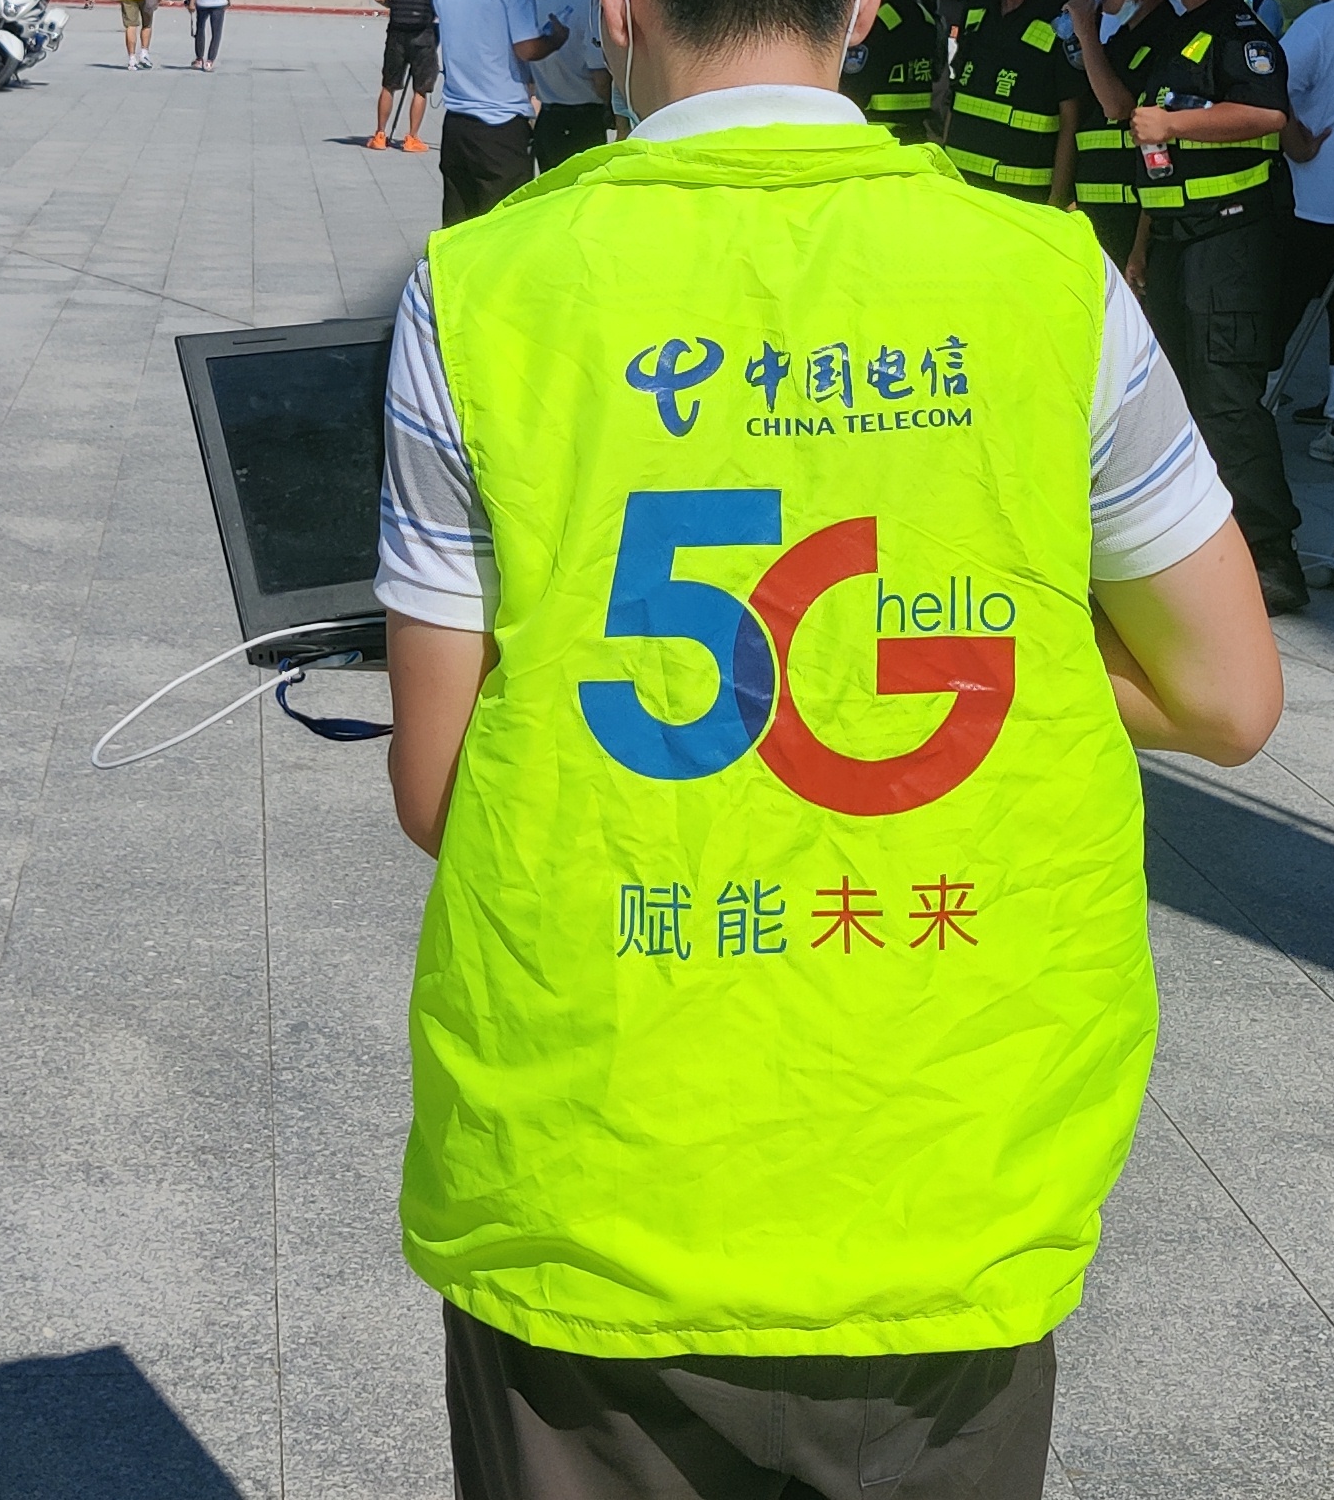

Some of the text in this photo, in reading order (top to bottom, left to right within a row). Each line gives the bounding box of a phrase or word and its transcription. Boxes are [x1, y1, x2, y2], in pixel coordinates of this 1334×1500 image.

[746, 335, 969, 411] 中国电信
[746, 408, 972, 437] CHINA TELECOM
[877, 576, 1015, 633] hello
[578, 489, 1015, 816] 5G
[617, 874, 978, 960] 赋能未来
